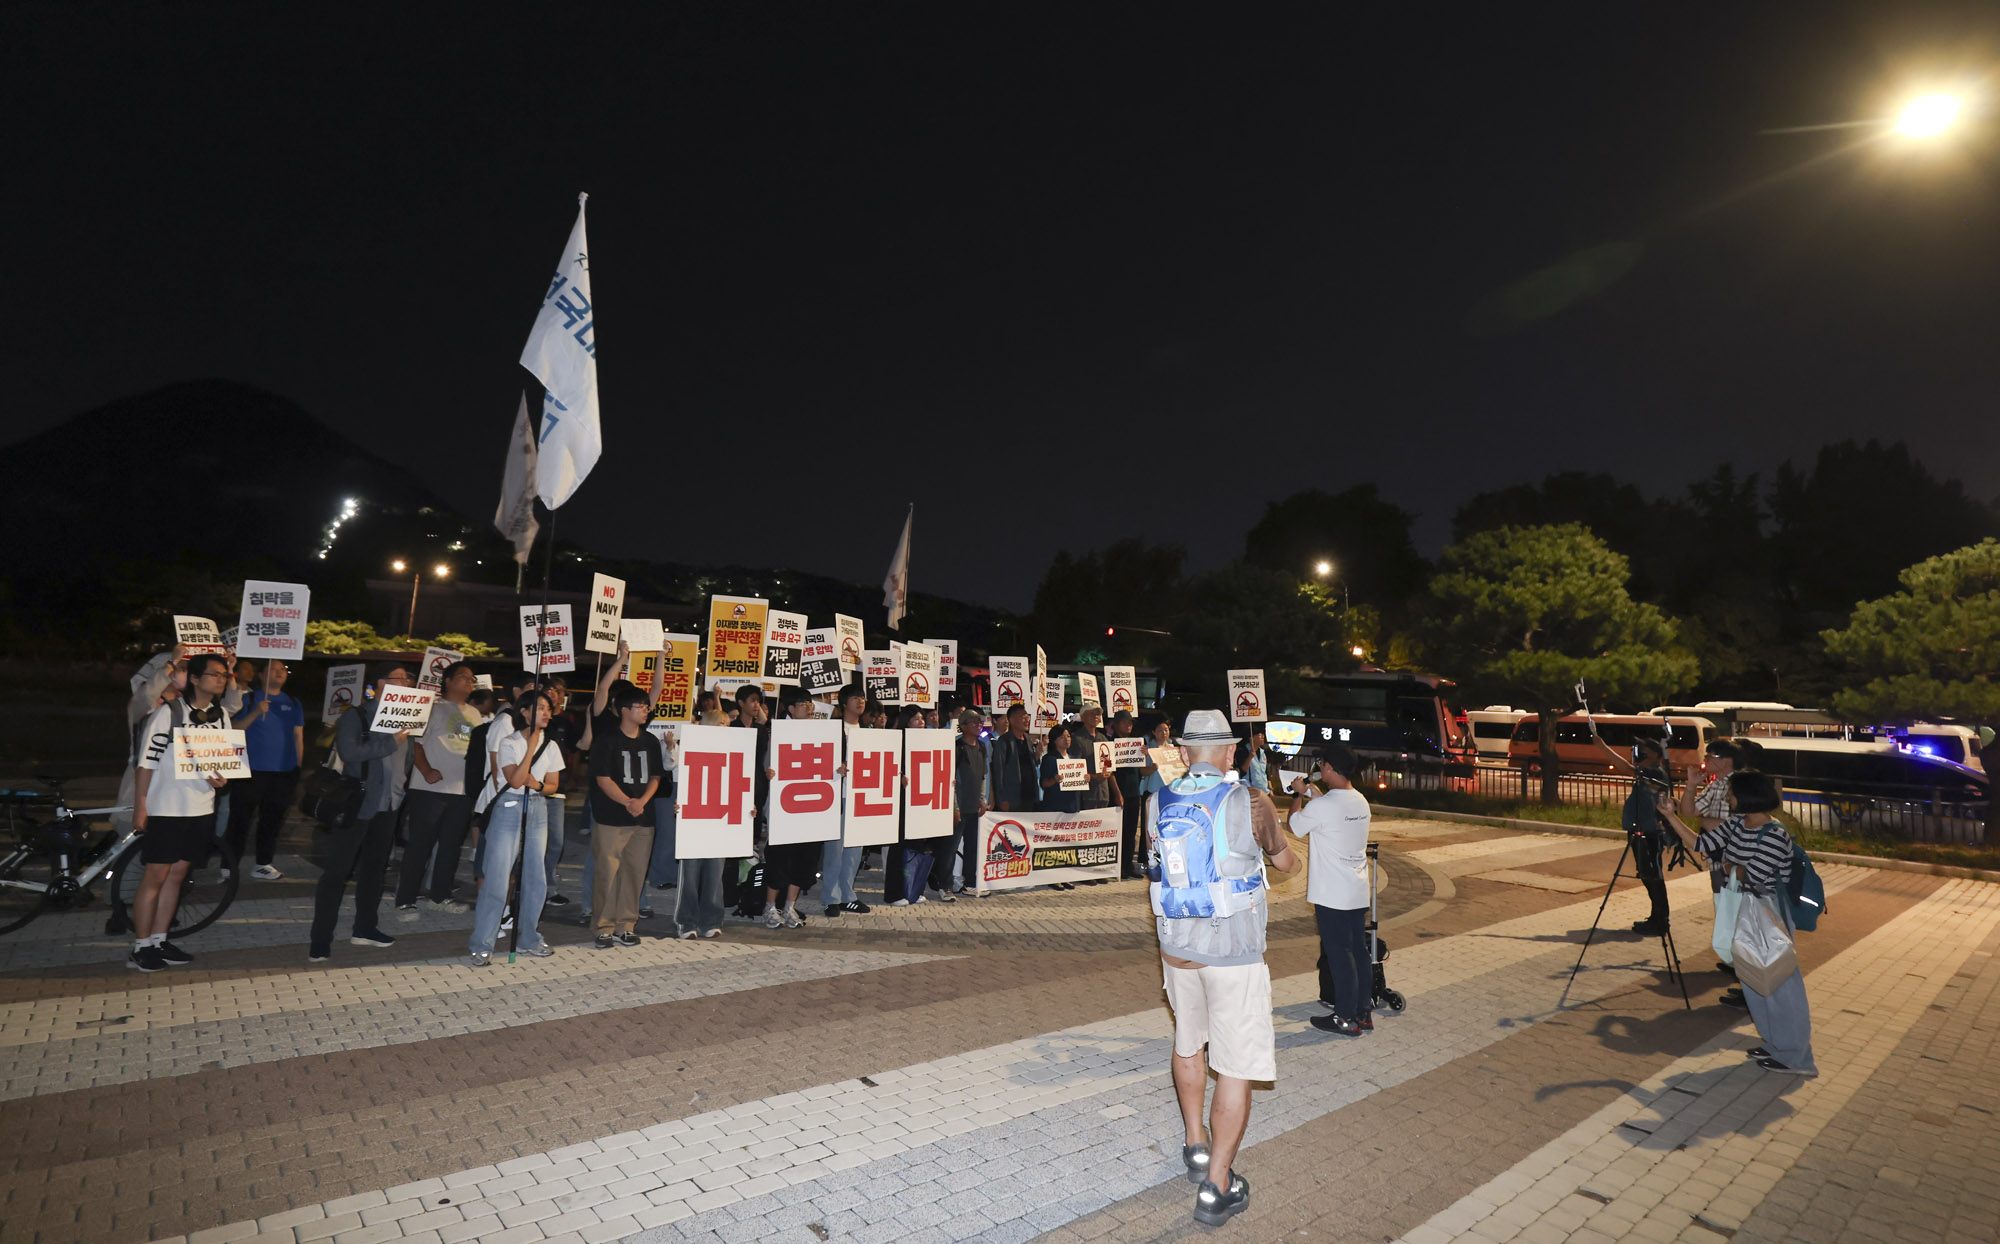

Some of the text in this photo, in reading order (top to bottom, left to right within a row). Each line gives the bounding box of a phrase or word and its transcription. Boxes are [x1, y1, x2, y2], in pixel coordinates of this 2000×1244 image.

[249, 591, 294, 606] 침략을
[603, 585, 615, 599] NO
[262, 606, 302, 619] 멈춰라!
[596, 601, 618, 616] NAVY
[245, 621, 290, 636] 전쟁을
[602, 619, 610, 628] TO
[716, 619, 762, 631] 이재명 정부는
[777, 618, 799, 631] 정부는
[590, 630, 617, 642] HORMUZ!
[715, 629, 762, 645] 침략전쟁
[771, 630, 801, 644] 파병 요구
[804, 633, 826, 645] 국의
[258, 637, 298, 650] 멈춰라!
[815, 644, 834, 656] 압박
[769, 649, 789, 662] 거부
[713, 659, 760, 674] 거부하라
[775, 662, 798, 676] 하라!
[801, 660, 824, 677] 규탄
[883, 666, 897, 676] 요구
[811, 670, 840, 687] 한다!
[868, 678, 887, 688] 거부
[1233, 681, 1260, 689] 거부하라!
[384, 693, 432, 705] DO NOT JOIN
[875, 687, 898, 699] 하라!
[380, 706, 423, 717] A WAR OF
[376, 719, 427, 729] AGGRESSION!
[193, 735, 227, 744] NAVAL
[1115, 741, 1121, 749] DO
[180, 761, 242, 773] TO HORMUZ!
[621, 750, 648, 784] 11
[778, 742, 835, 814] 병
[852, 751, 898, 817] 반
[910, 749, 951, 810] 대
[681, 752, 750, 825] 파
[1078, 819, 1103, 829] 중단하라!
[1033, 834, 1052, 843] 정부는
[1094, 829, 1118, 839] 거부하라!
[1033, 845, 1117, 867] 파병반대 평화행진
[986, 859, 1029, 880] 파병반대
